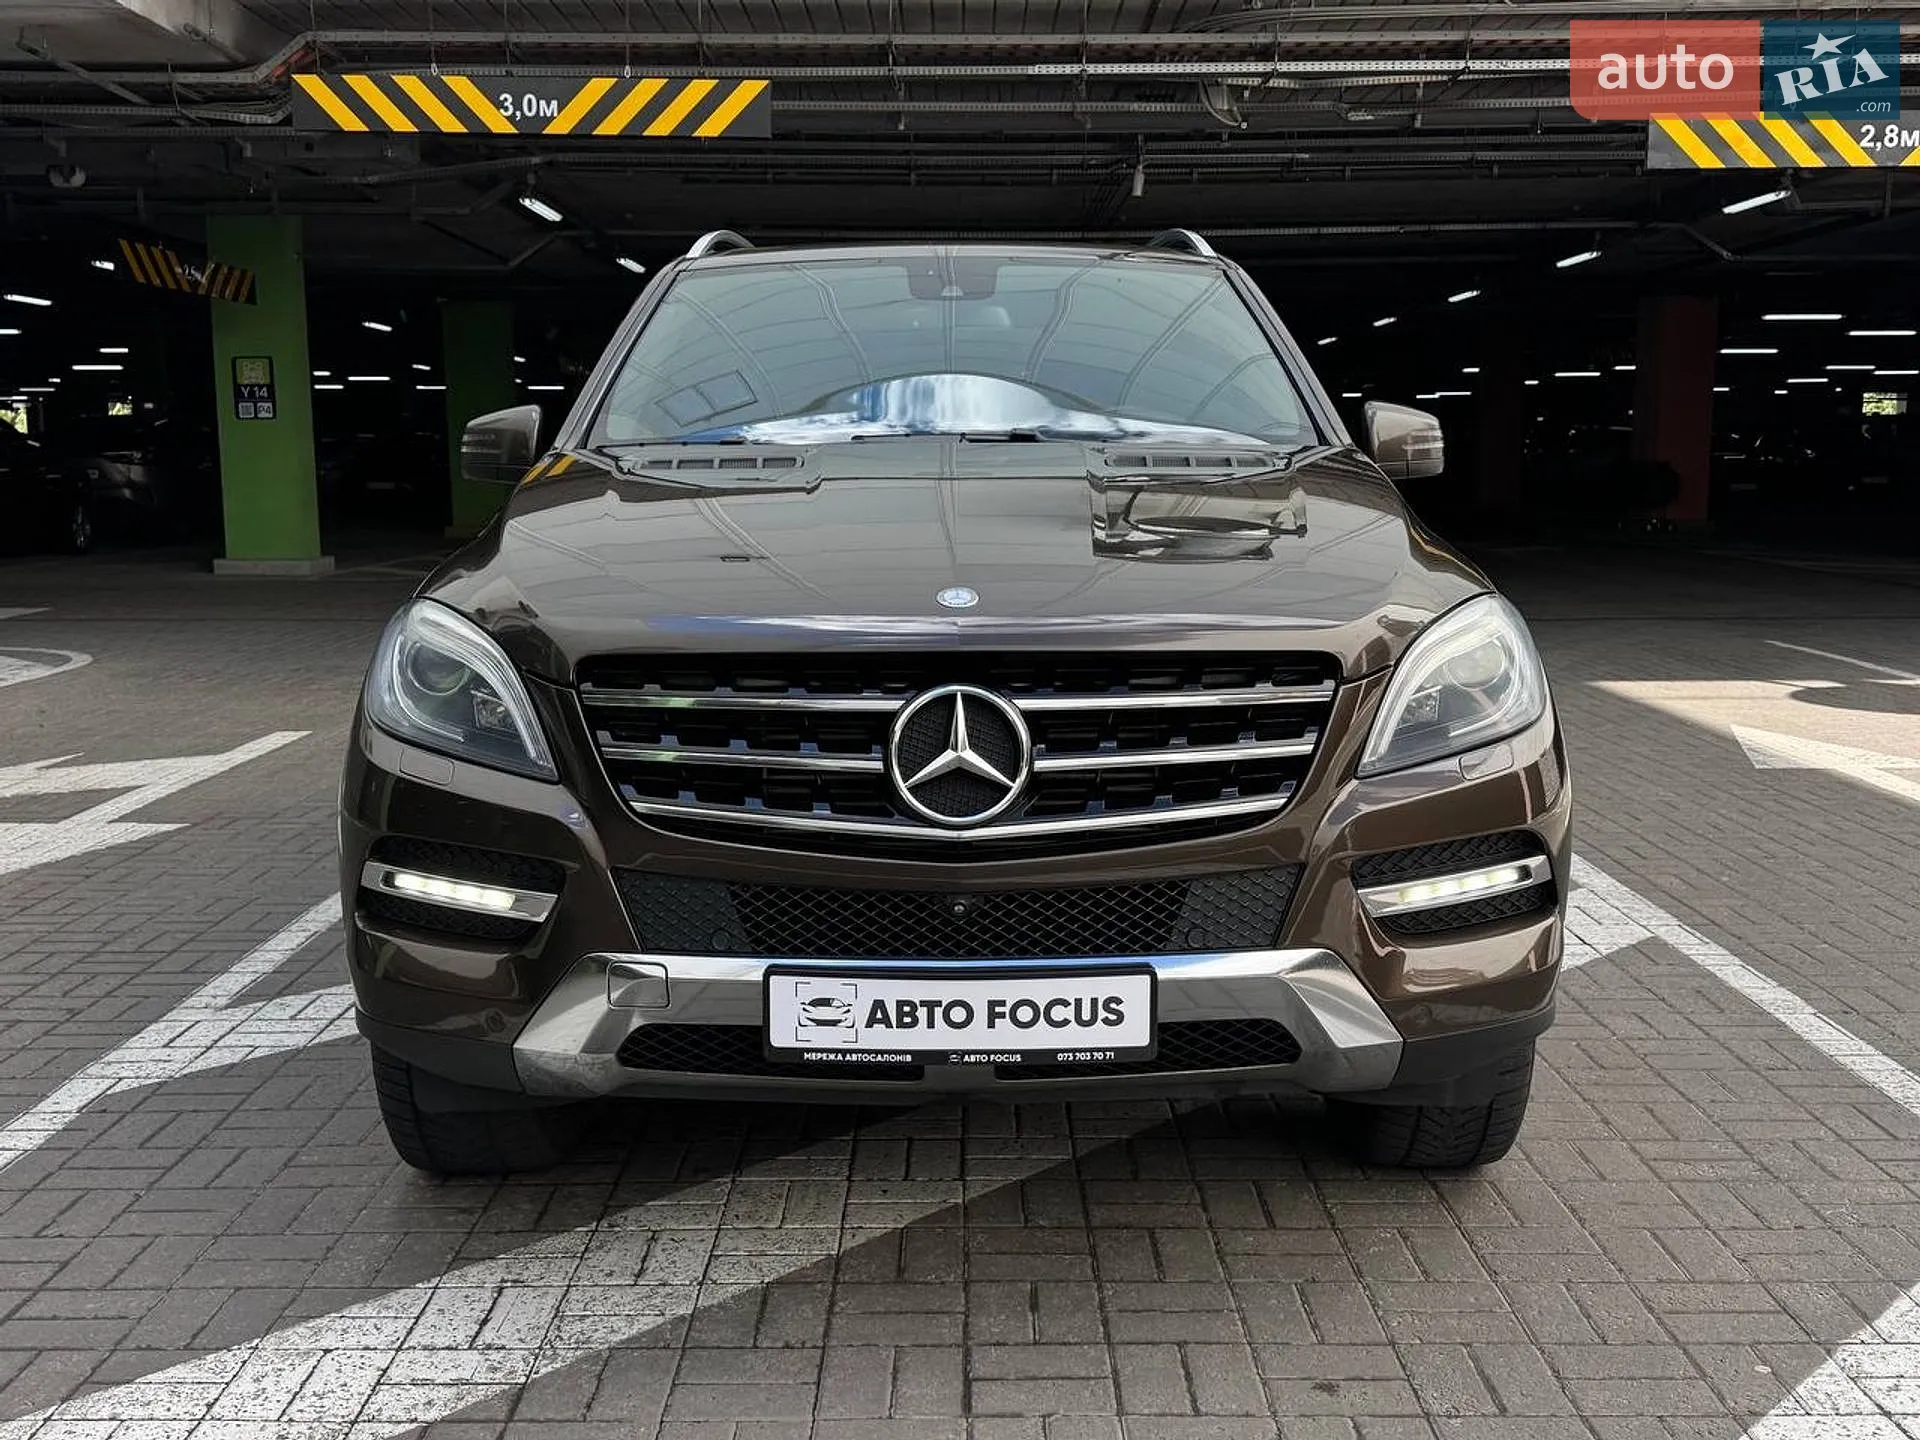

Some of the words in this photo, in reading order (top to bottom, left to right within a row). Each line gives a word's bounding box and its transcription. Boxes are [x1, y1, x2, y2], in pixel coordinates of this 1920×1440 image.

[253, 386, 268, 399] 14
[864, 999, 975, 1030] АВТО
[986, 996, 1125, 1029] FOCUS
[803, 1052, 843, 1062] МЕРЕЖА
[845, 1053, 912, 1062] АВТОСАЛОНІВ
[963, 1054, 987, 1062] АВТО
[989, 1054, 1021, 1062] FOCUS
[1057, 1053, 1073, 1061] 073
[1075, 1052, 1091, 1061] 703
[1092, 1052, 1103, 1060] 70
[1105, 1052, 1115, 1060] 71
